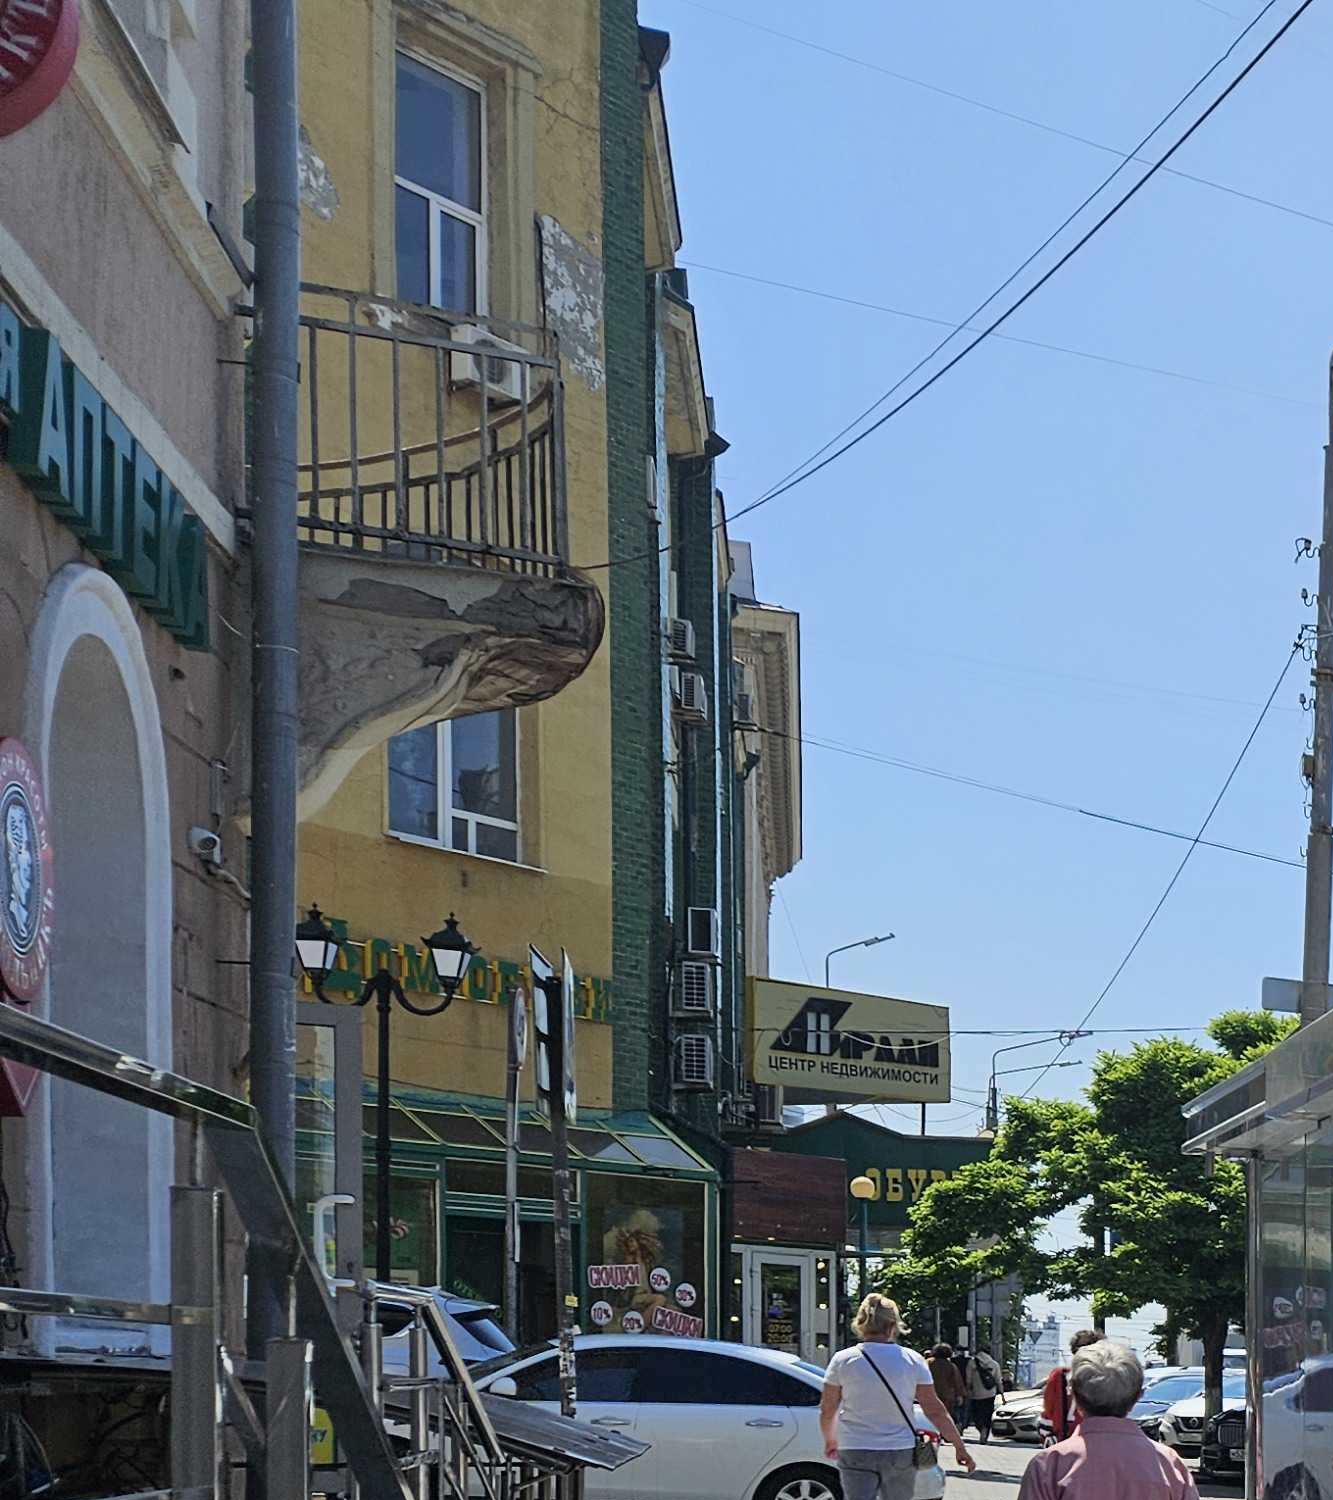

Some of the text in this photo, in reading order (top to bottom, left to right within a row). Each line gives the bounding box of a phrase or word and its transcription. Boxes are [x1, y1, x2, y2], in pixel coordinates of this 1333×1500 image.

[37, 333, 207, 642] АПТЕКА
[768, 1055, 939, 1086] ЦЕНТР НЕДВИЖИМОСТИ
[864, 1167, 960, 1201] ОБУ
[591, 1266, 640, 1289] СКИДКИ
[593, 1307, 611, 1320] 10%
